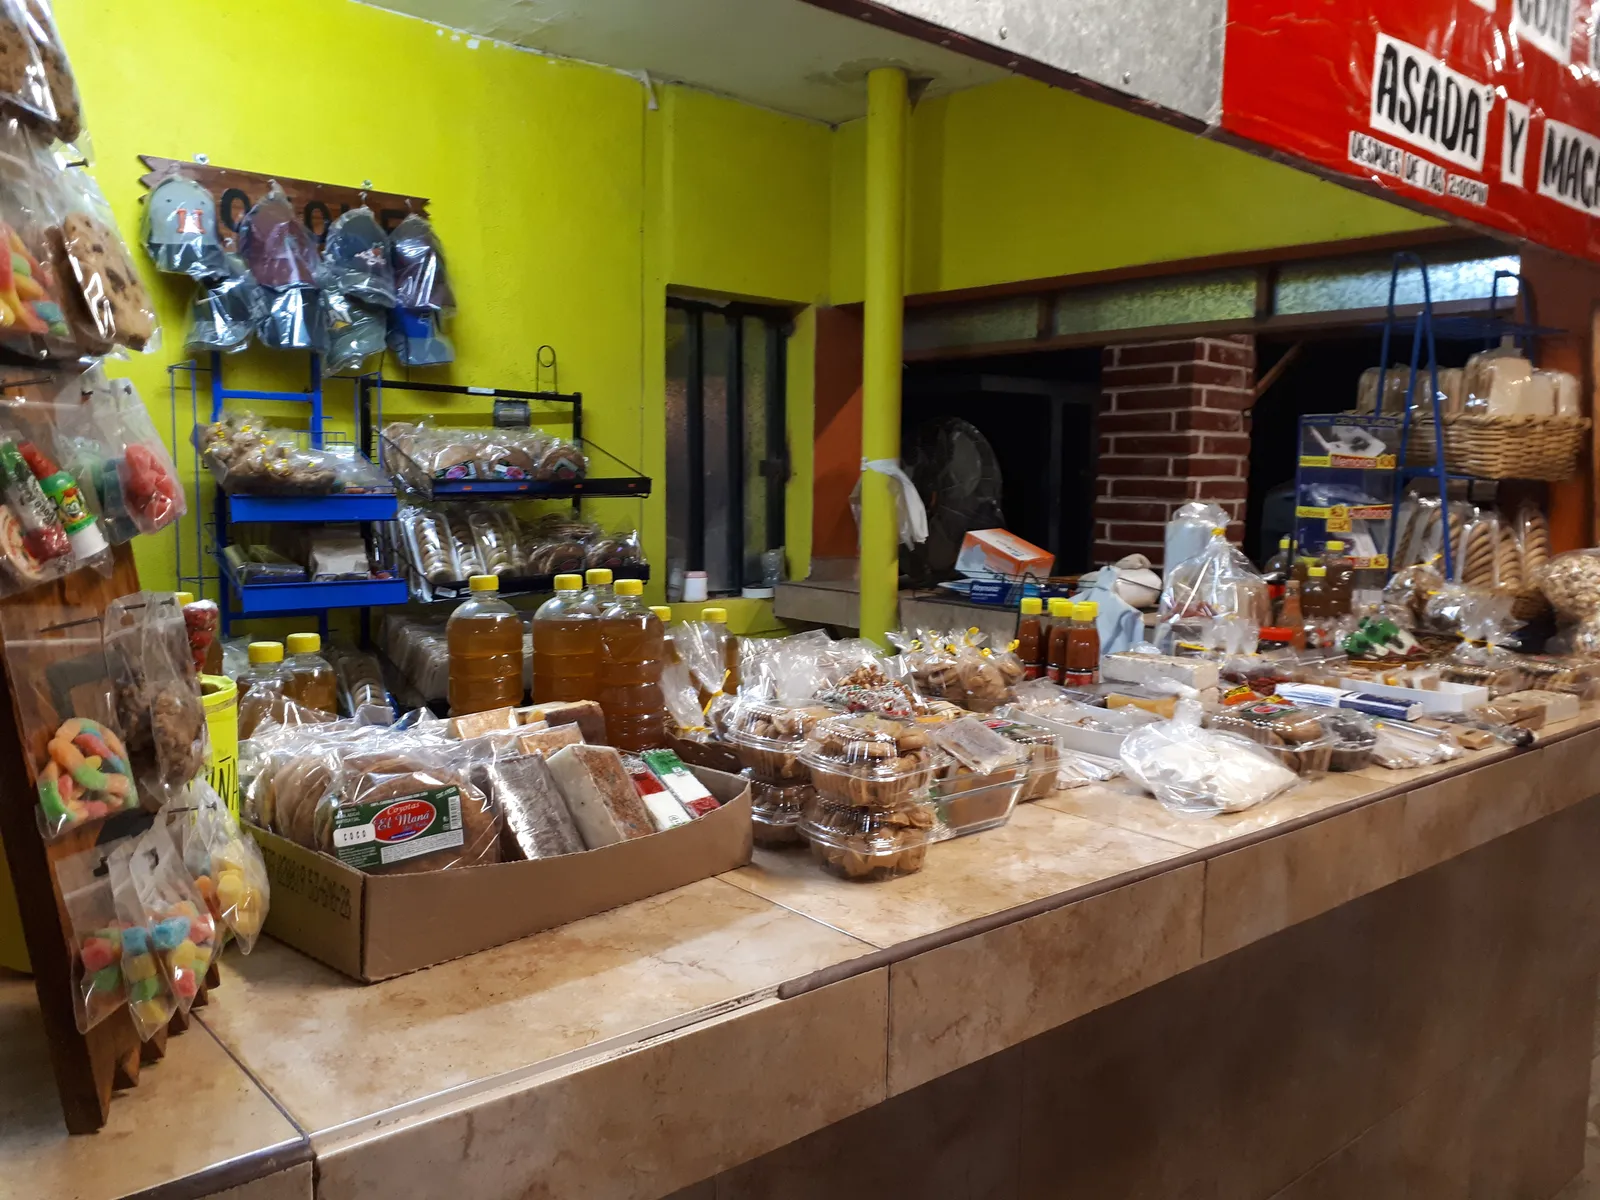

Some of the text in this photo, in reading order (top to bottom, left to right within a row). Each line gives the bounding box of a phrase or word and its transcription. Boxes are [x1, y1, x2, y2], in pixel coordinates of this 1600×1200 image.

[1376, 43, 1483, 161] ASADA
[1509, 110, 1525, 174] Y
[386, 801, 420, 816] Coyotas
[395, 810, 430, 826] Maná
